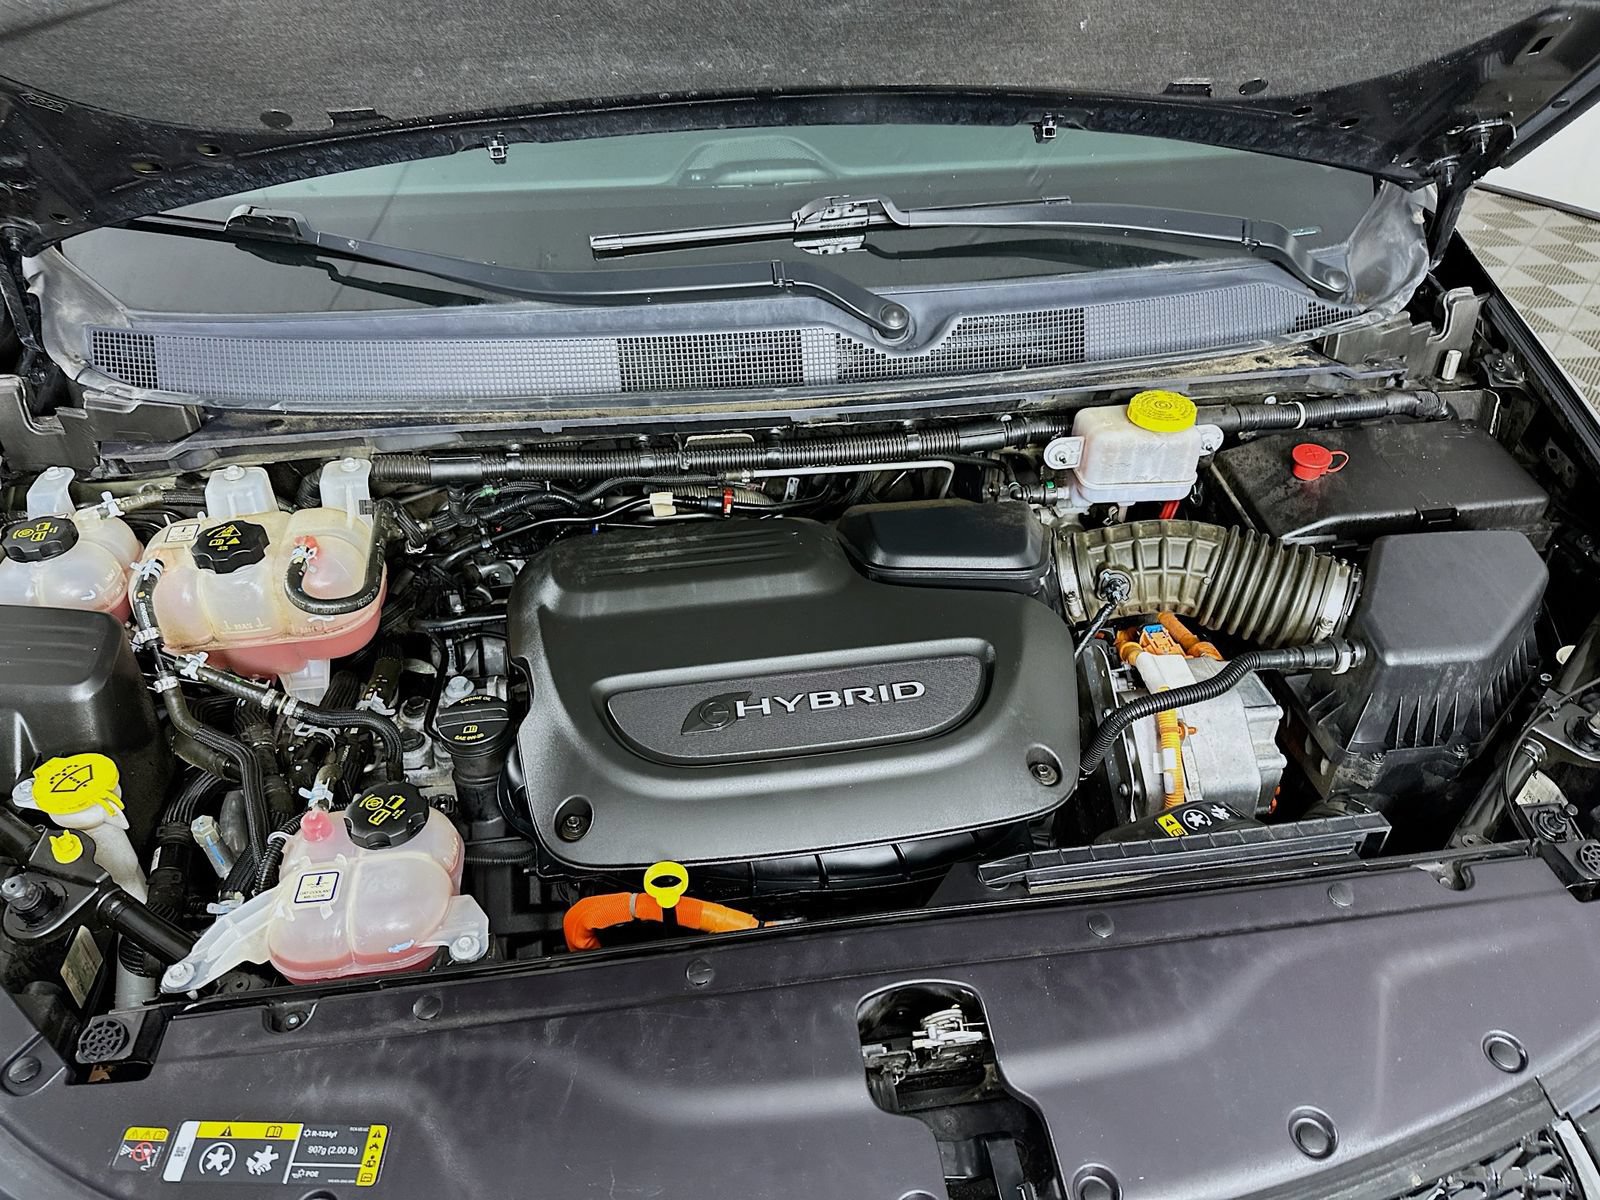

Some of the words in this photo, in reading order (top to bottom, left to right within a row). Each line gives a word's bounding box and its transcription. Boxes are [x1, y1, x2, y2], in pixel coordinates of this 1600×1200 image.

[460, 695, 482, 704] ENGINE
[736, 680, 926, 719] HYBRID
[311, 1130, 338, 1139] R-1234yf
[307, 1145, 327, 1156] 907g
[327, 1145, 347, 1156] (2.00
[347, 1146, 359, 1156] lb)
[305, 1170, 319, 1178] POE
